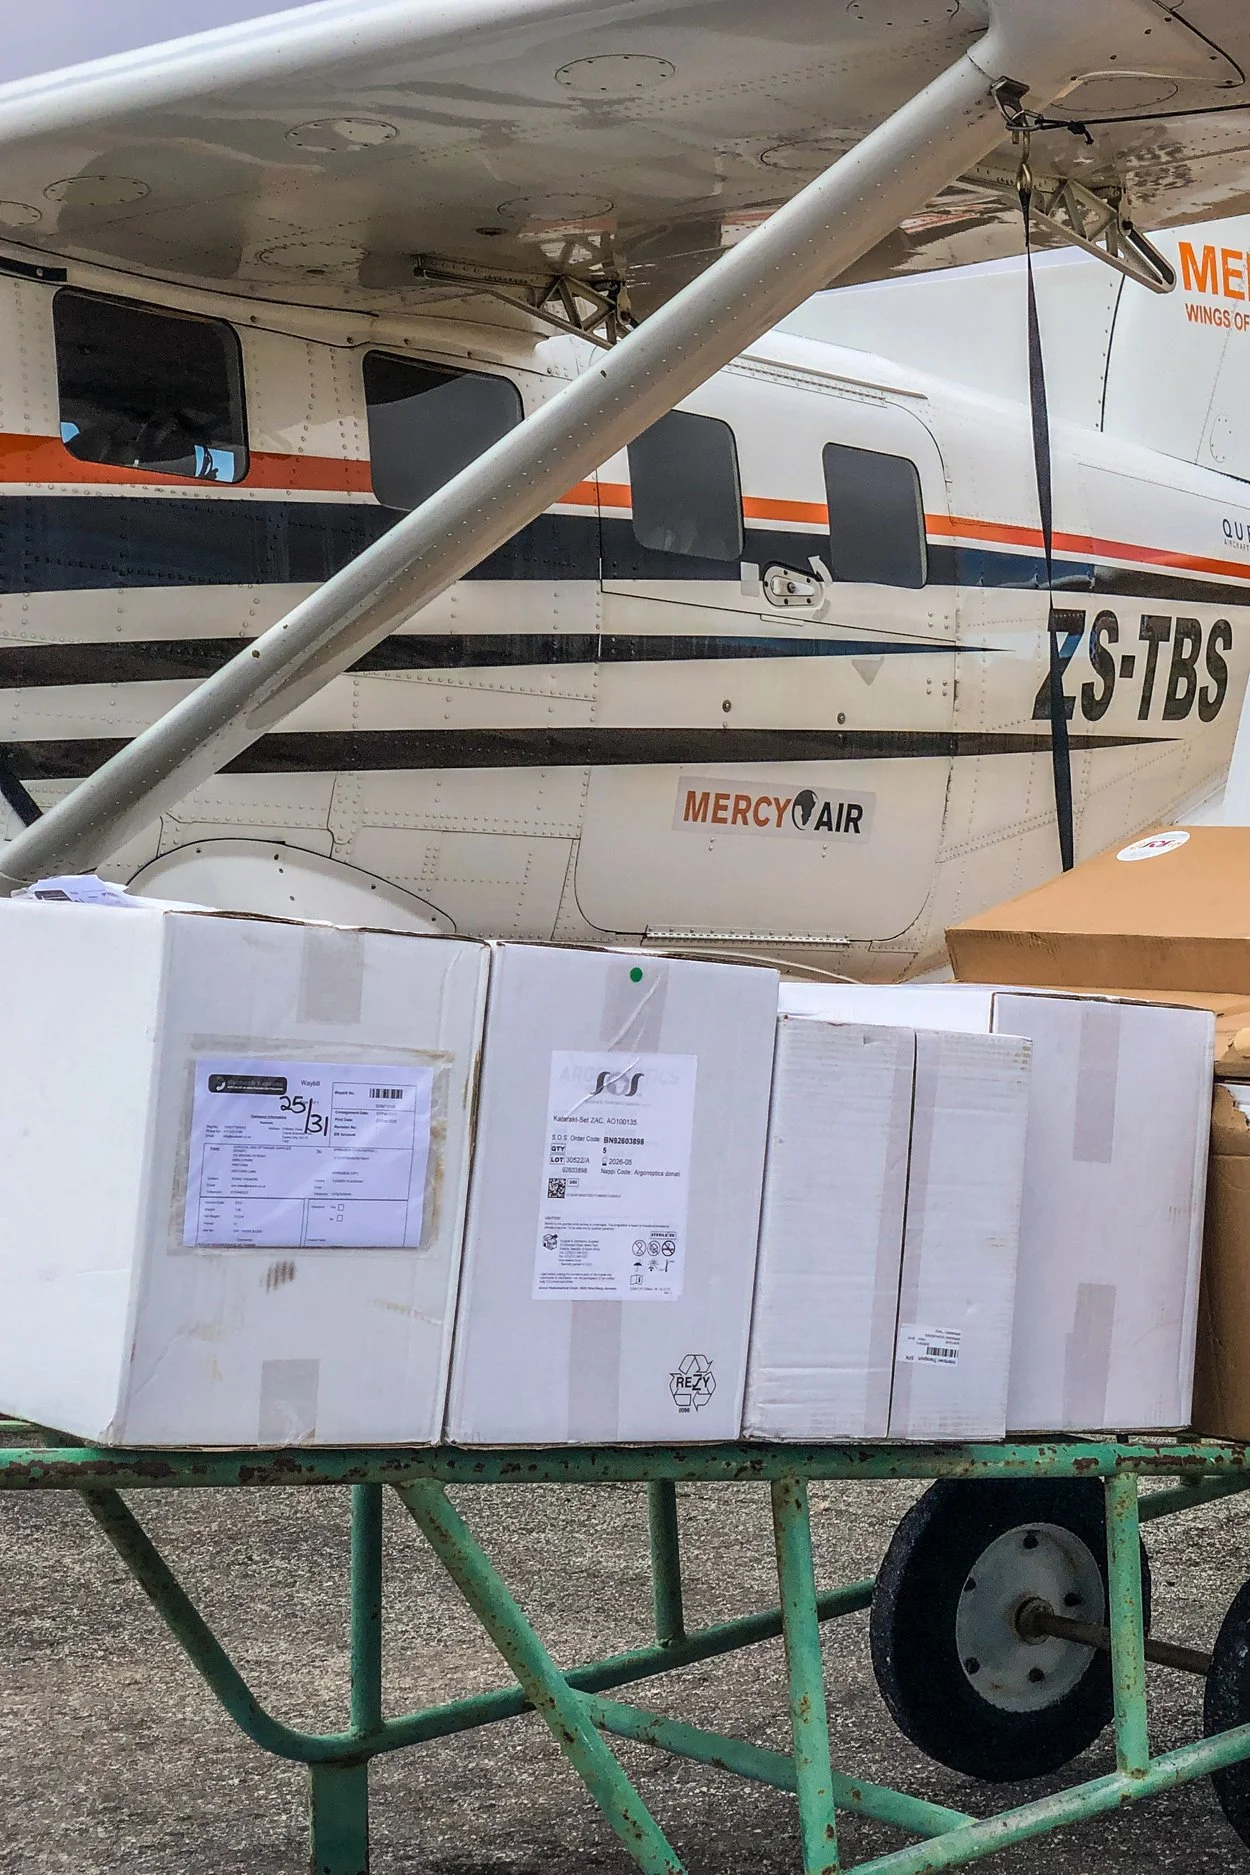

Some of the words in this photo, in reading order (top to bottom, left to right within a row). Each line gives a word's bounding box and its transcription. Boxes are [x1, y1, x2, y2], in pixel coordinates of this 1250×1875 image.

[1185, 302, 1231, 329] WINGS
[1234, 312, 1250, 332] OF
[1031, 607, 1233, 723] ZS-TBS
[683, 790, 792, 828] MERCY
[813, 801, 864, 834] AIR
